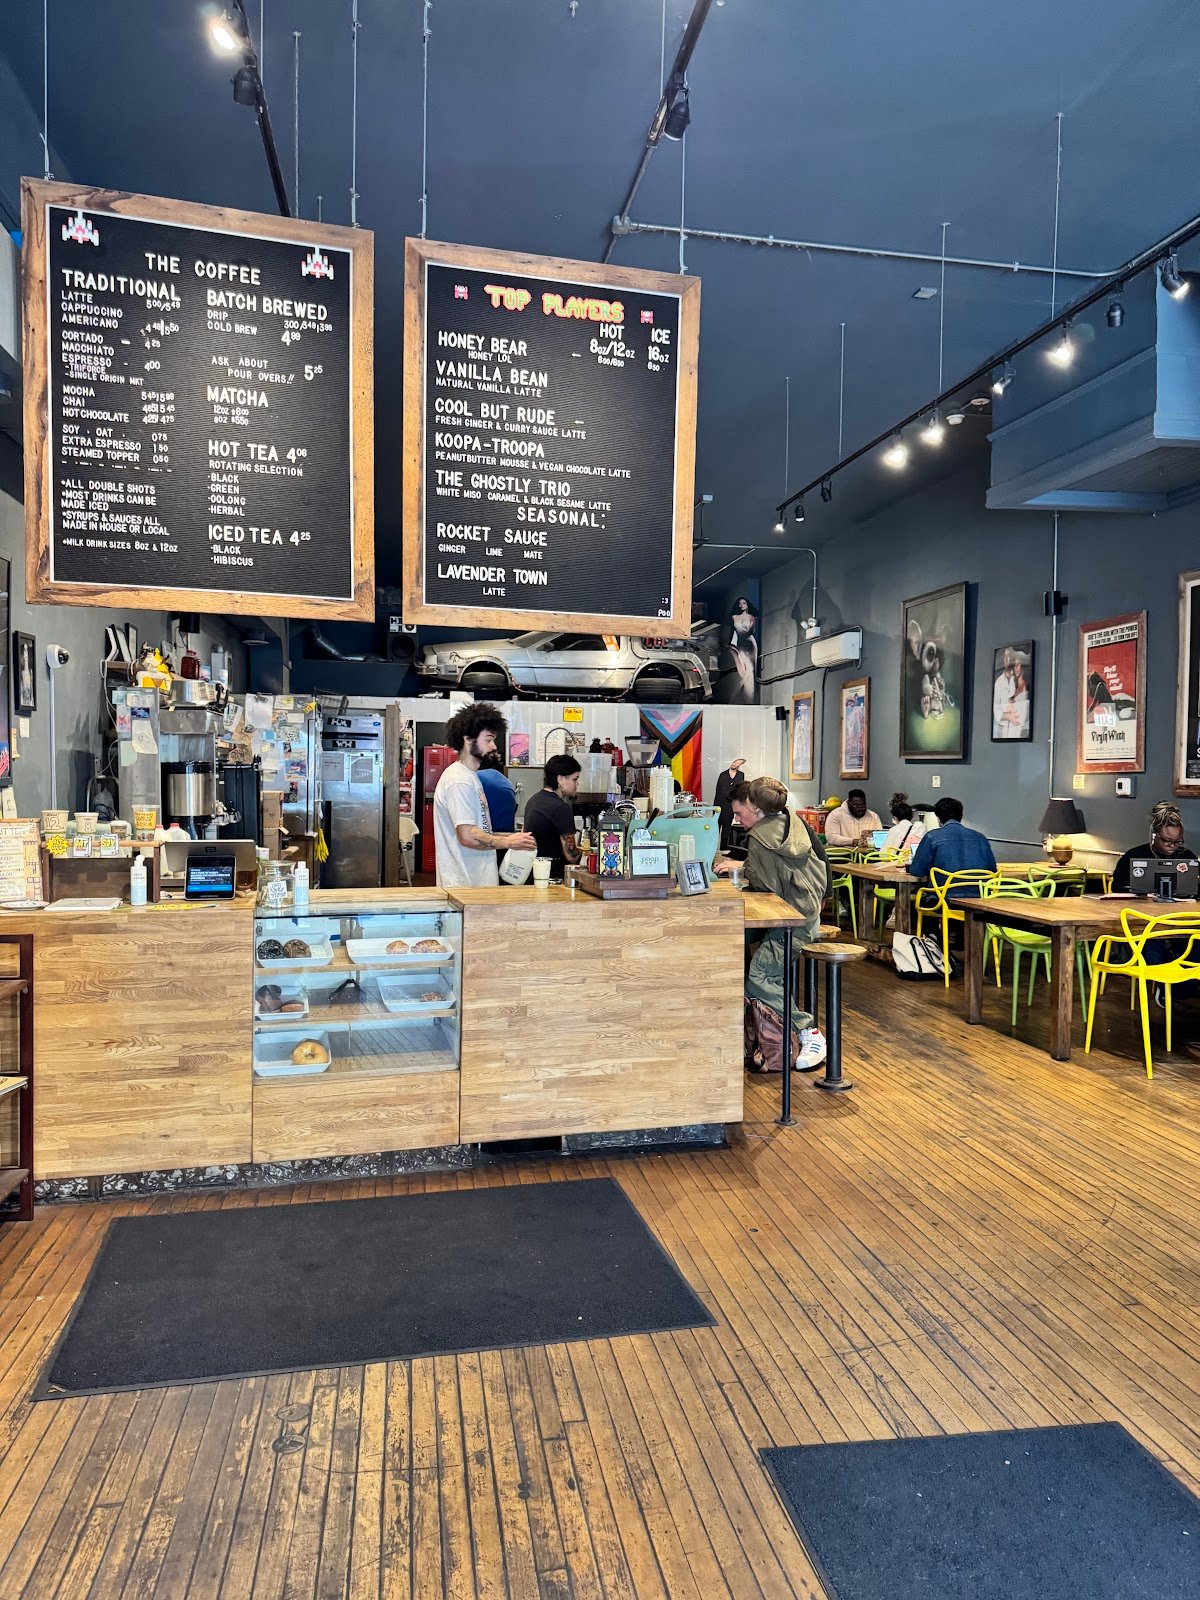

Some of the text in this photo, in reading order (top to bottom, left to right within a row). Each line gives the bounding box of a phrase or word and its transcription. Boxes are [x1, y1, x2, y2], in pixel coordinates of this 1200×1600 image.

[145, 252, 261, 285] THE COFFEE
[62, 269, 181, 301] TRADITIONAL
[62, 290, 93, 303] LATTE
[484, 284, 625, 323] TOP PLAYERS
[61, 302, 123, 319] CAPPUCCINO
[207, 289, 328, 321] BATCH BREWED
[62, 314, 119, 329] AMERICANO
[207, 310, 228, 321] DRIP
[208, 321, 232, 333] COLD
[235, 323, 258, 336] BREW
[600, 323, 671, 345] HOT ICE
[62, 331, 103, 344] CORTADO
[439, 331, 485, 351] HONEY
[491, 338, 527, 357] BEAR
[62, 341, 114, 356] MACCHIATO
[62, 352, 161, 372] ESPRESSO 400
[212, 356, 268, 369] ASK ABOUT
[468, 351, 493, 361] HONEY
[498, 354, 513, 364] LOL
[130, 377, 144, 386] MKT
[228, 369, 252, 380] POUR
[436, 360, 548, 388] VANILLA BEAN
[63, 385, 95, 397] MOCHA
[436, 377, 542, 398] NATURAL VANILLA LATTE
[63, 396, 85, 407] CHAI
[207, 385, 269, 408] MATCHA
[63, 408, 80, 419] HOT
[81, 409, 129, 423] CHOCOLATE
[435, 398, 556, 426] COOL BUT RUDE
[63, 425, 80, 435] SOY
[96, 428, 113, 438] OAT
[436, 415, 587, 440] FRESH GINGER & CURRY SAUCE LATTE
[63, 436, 93, 447] EXTRA
[96, 438, 141, 452] ESPRESSO
[209, 439, 240, 458] HOT
[247, 443, 279, 462] TEA
[435, 432, 545, 459] KOOPA-TROOPA
[62, 447, 103, 459] STEAMED
[106, 450, 140, 462] TOPPER
[209, 460, 303, 477] ROTATING SELECTION
[436, 451, 631, 479] PEANUTBUTTER MOUSSE & VEGAN CHOCOLATE LATTE
[89, 480, 124, 492] DOUBLE
[127, 484, 156, 495] SHOTS
[436, 470, 571, 497] THE GHOSTLY TRIO
[61, 499, 109, 512] MADE ICED
[93, 492, 125, 504] DRINKS
[127, 495, 144, 505] CAN
[146, 497, 157, 506] BE
[436, 487, 612, 511] WHITE MISO CARAMEL & BLACK SESAME LATTE
[102, 513, 108, 522] &
[109, 514, 142, 524] SAUCES
[144, 517, 161, 526] ALL
[517, 507, 606, 529] SEASONAL:
[63, 521, 170, 536] MADE IN HOUSE OR LOCAL
[209, 524, 245, 542] ICED
[249, 527, 283, 545] TEA
[86, 539, 108, 548] DRINK
[109, 541, 131, 550] SIZES
[438, 544, 543, 560] GINGER LIME MATE
[438, 563, 548, 585] LAVENDER TOWN
[483, 587, 506, 597] LATTE
